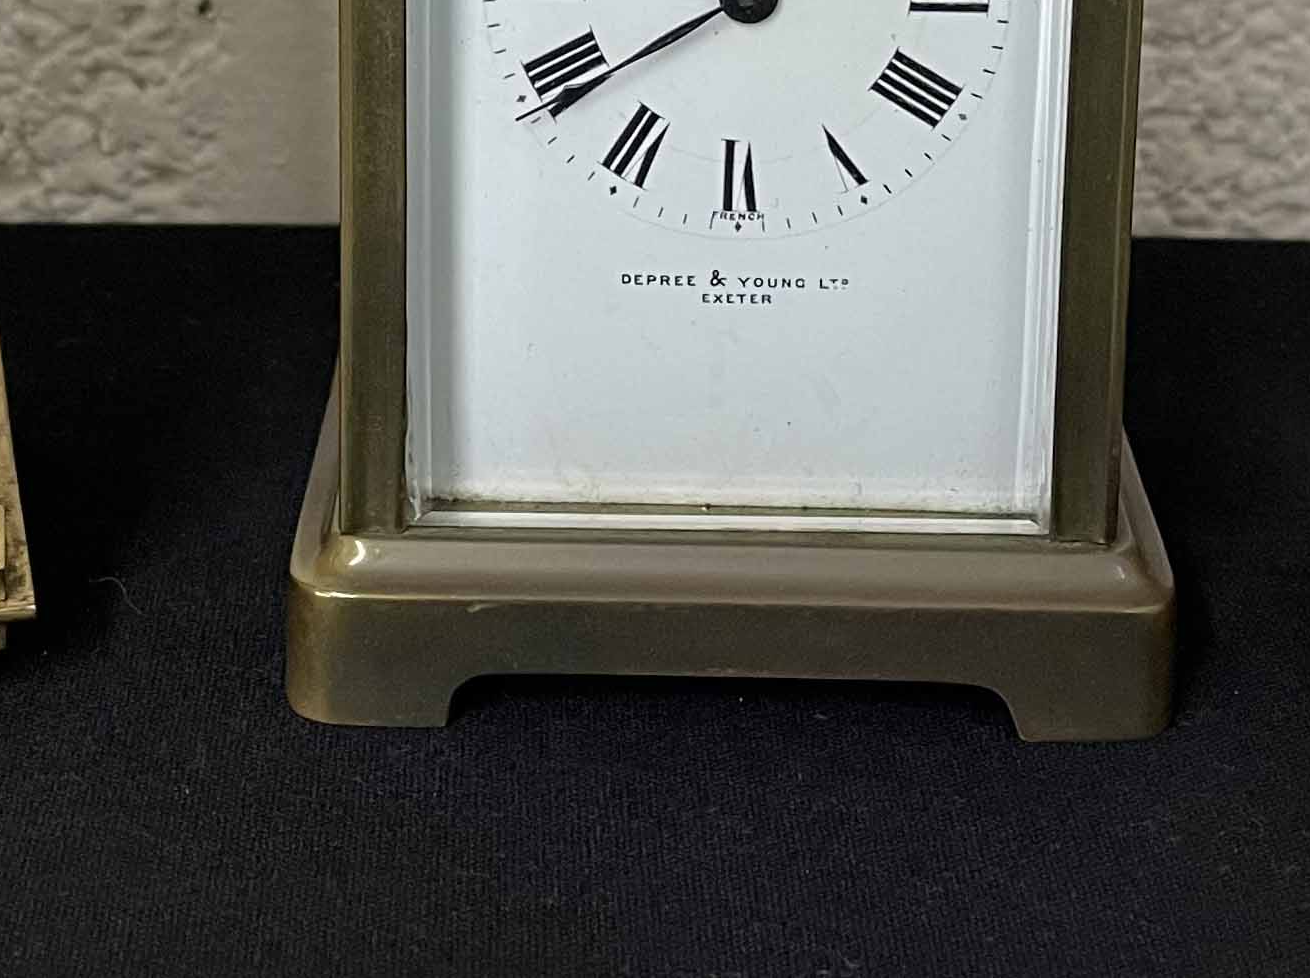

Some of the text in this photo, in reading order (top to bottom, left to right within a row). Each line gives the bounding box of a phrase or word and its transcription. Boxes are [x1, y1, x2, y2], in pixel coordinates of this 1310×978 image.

[869, 47, 966, 129] IIII
[601, 101, 670, 191] VII
[721, 138, 757, 212] VI
[821, 124, 868, 193] V
[709, 210, 765, 231] FRENCH
[621, 274, 697, 286] DEPREE
[709, 269, 727, 287] &
[737, 277, 805, 288] YOUNG
[702, 293, 772, 304] EXETER
